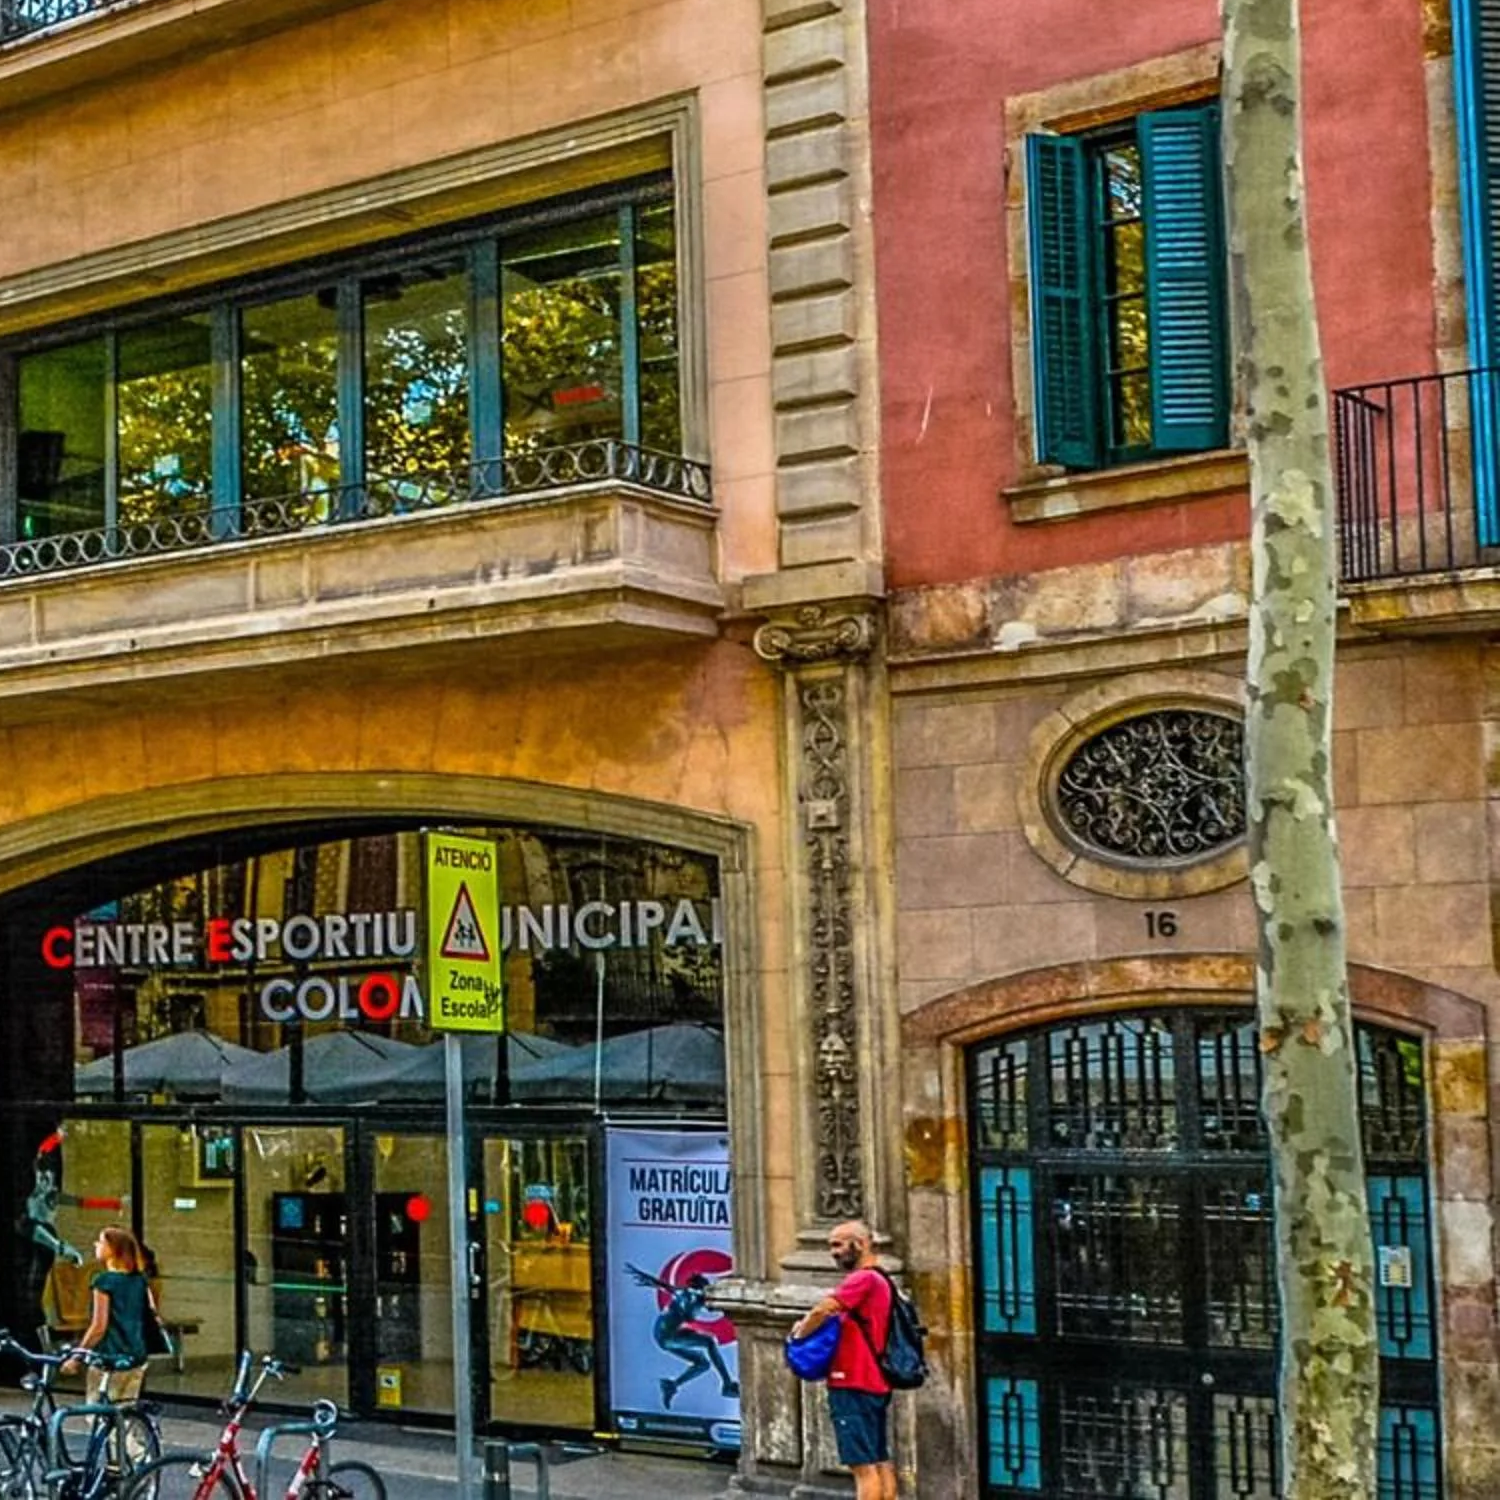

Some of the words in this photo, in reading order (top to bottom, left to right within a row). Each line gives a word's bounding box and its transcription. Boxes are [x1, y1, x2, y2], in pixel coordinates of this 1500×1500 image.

[435, 845, 492, 872] ATENCIÓ
[41, 919, 195, 969] CENTRE
[206, 910, 416, 962] ESPORTIU
[501, 897, 725, 951] NICIPA
[1144, 911, 1177, 939] 16
[449, 969, 483, 992] Zona
[639, 1195, 730, 1224] GRATUÏTA
